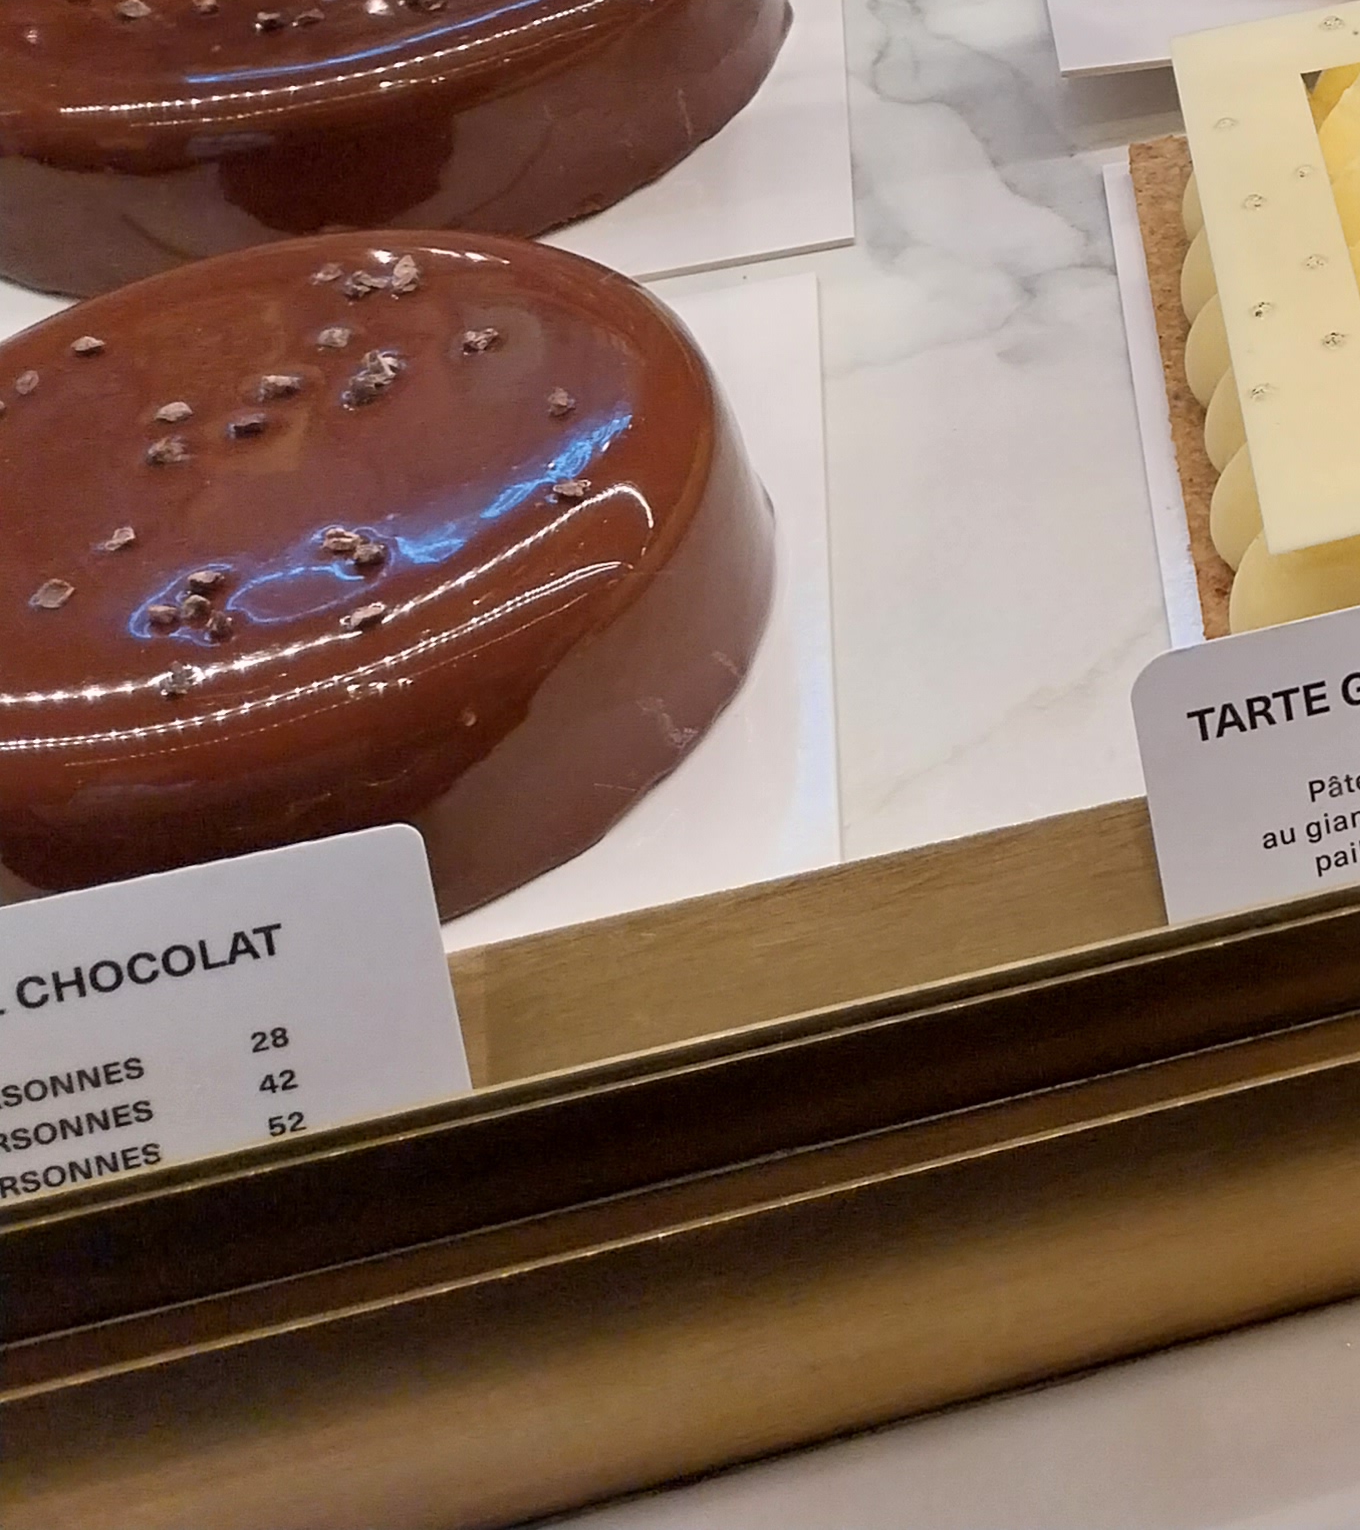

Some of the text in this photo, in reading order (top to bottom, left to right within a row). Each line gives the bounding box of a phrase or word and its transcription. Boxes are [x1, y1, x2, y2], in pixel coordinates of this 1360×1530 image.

[1187, 681, 1330, 742] TARTE
[1262, 826, 1296, 850] au
[16, 923, 282, 1009] CHOCOLAT
[0, 1027, 289, 1108] SONNES 28
[259, 1069, 298, 1094] 42
[268, 1111, 307, 1137] 52
